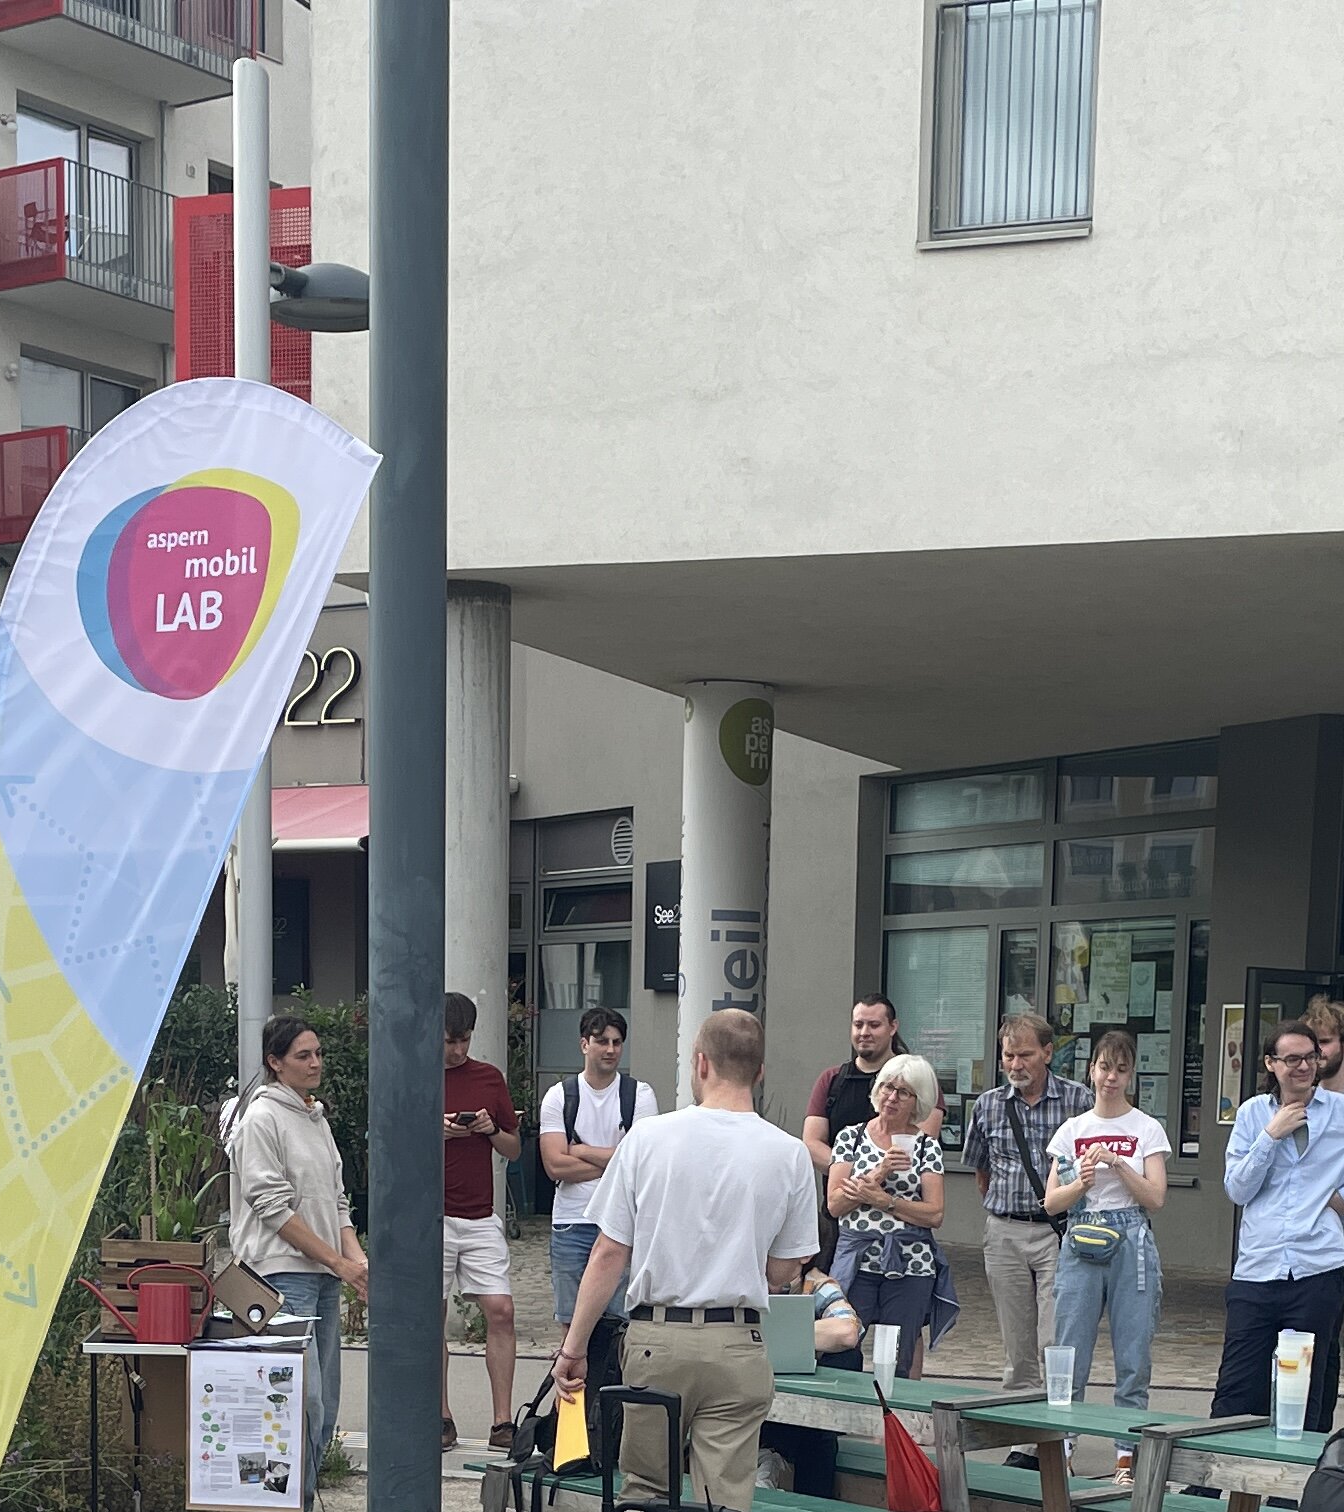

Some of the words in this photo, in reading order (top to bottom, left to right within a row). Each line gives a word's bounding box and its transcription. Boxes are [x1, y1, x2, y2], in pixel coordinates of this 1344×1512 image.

[147, 526, 209, 553] aspern
[184, 547, 258, 579] mobil
[155, 590, 224, 633] LAB
[284, 646, 361, 727] 22
[751, 716, 771, 736] as
[745, 733, 768, 755] pe
[750, 751, 769, 770] rn
[1080, 1140, 1133, 1155] LVI'S
